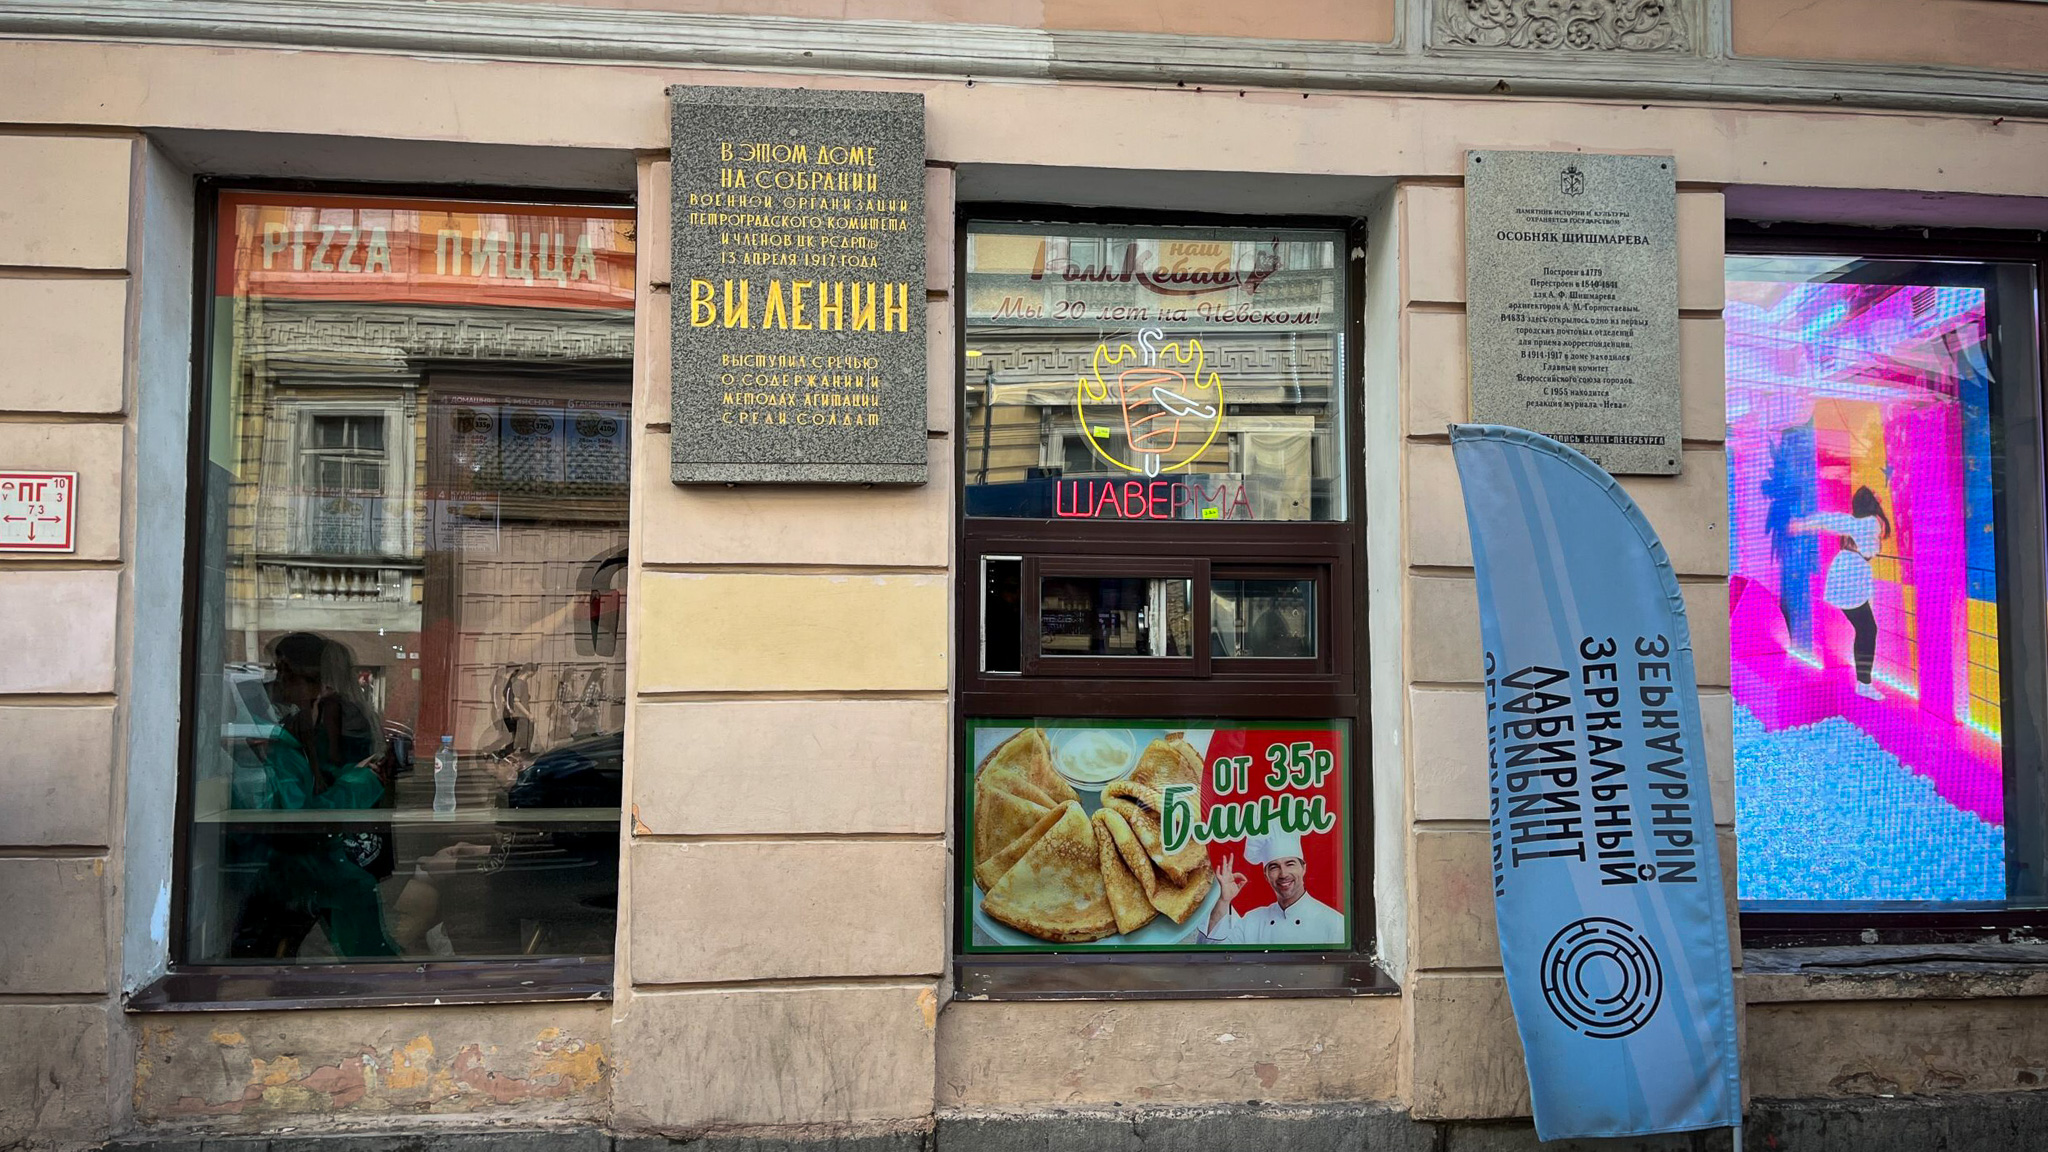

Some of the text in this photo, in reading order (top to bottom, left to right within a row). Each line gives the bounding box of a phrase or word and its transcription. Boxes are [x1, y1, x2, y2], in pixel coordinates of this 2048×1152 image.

[721, 142, 877, 167] В ЭТОМ ДОМЕ
[721, 168, 878, 192] НА СОБРАНИИ
[783, 196, 908, 212] ОРГАНИЗАЦИИ
[690, 212, 908, 232] ПЕТРОГРАДСКОГО КОМИТЕТА
[721, 232, 729, 246] И
[734, 233, 792, 247] ЧЛЕНОВ
[797, 234, 814, 248] ЦК
[1497, 231, 1650, 245] ОСОБНЯК ШИШМАРЕВА
[261, 222, 393, 274] PIZZA
[1169, 242, 1223, 257] наш
[435, 229, 598, 288] ПИЦЦА
[721, 251, 878, 268] 13 АПРЕЛЯ 1917 ГОДА
[1543, 267, 1579, 278] Построен
[1530, 278, 1573, 289] Перестроен
[1569, 291, 1616, 301] Шишмарева
[762, 279, 908, 332] ЛЕНИН
[992, 296, 1321, 325] Мы 20 лет на Невском!
[1516, 327, 1554, 337] городских
[722, 353, 878, 370] ВЫСТУПИЛ С РЕЧЬЮ
[721, 374, 879, 389] О СОДЕРЖАНИИ И
[722, 392, 879, 408] МЕТОДАХ АГИТАЦИИ
[1543, 388, 1550, 396] С
[1570, 390, 1610, 398] находится
[722, 412, 879, 426] СРЕДИ СОЛДАТ
[1584, 435, 1665, 445] САНКТ-ПЕТЕРБУРГА
[19, 482, 47, 501] ПГ
[54, 479, 65, 489] 10
[56, 492, 63, 502] 3
[1056, 480, 1255, 520] ШАВЕРМА
[1532, 665, 1587, 862] ЛАБИРИНТ
[1579, 635, 1655, 886] ЗЕРКАЛЬНЫЙ
[1162, 783, 1336, 855] Блины
